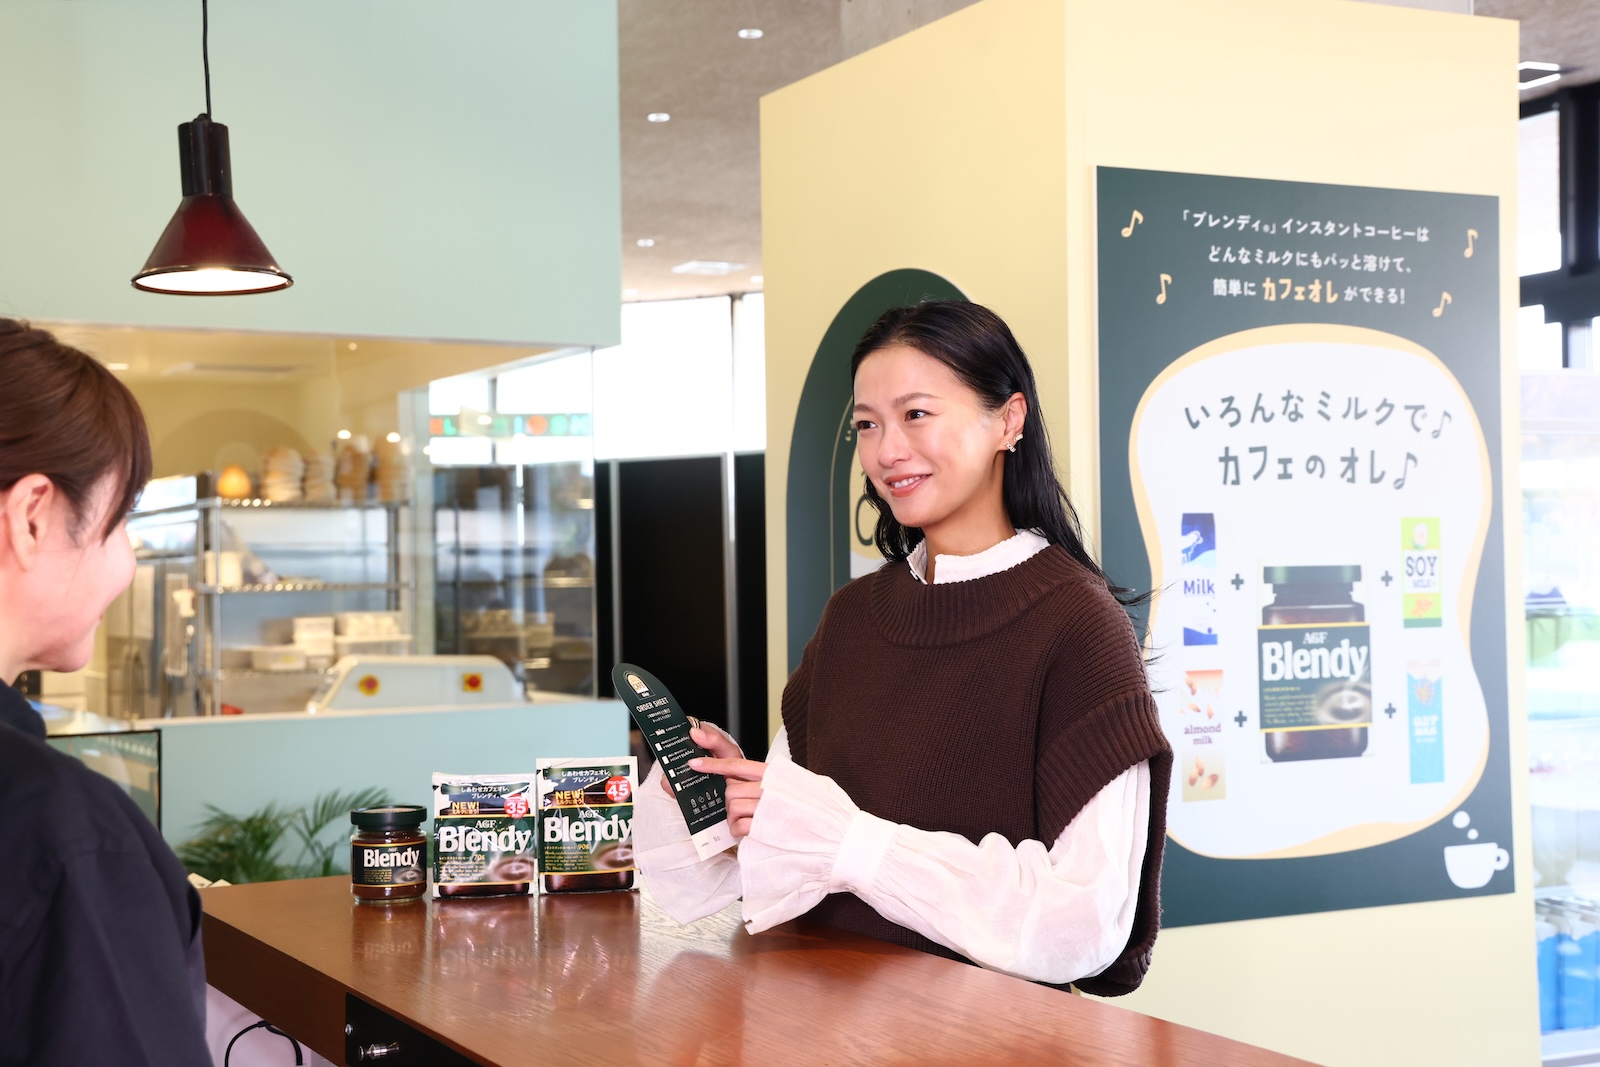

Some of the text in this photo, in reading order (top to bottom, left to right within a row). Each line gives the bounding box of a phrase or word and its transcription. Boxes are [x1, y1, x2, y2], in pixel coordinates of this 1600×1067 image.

[1207, 245, 1413, 274] どんなミルクにもパッと溶けて、
[1212, 277, 1256, 297] 簡単に
[1261, 277, 1339, 304] カフェオレ
[1184, 388, 1428, 433] いろんなミルクで
[1405, 555, 1437, 577] SOY
[1183, 578, 1215, 595] Milk
[1302, 631, 1328, 644] AGF
[1261, 638, 1369, 683] Blendy
[636, 697, 669, 713] ORDER SHEET
[1184, 723, 1222, 735] almond
[1192, 735, 1213, 745] milk
[555, 789, 584, 799] NEW!
[607, 785, 630, 797] 45
[451, 801, 480, 810] NEW!
[506, 803, 527, 814] 35
[578, 809, 600, 819] AGF
[475, 820, 498, 829] AGF
[544, 814, 633, 842] Blendy
[438, 825, 532, 855] Blendy
[363, 846, 420, 868] Blendy
